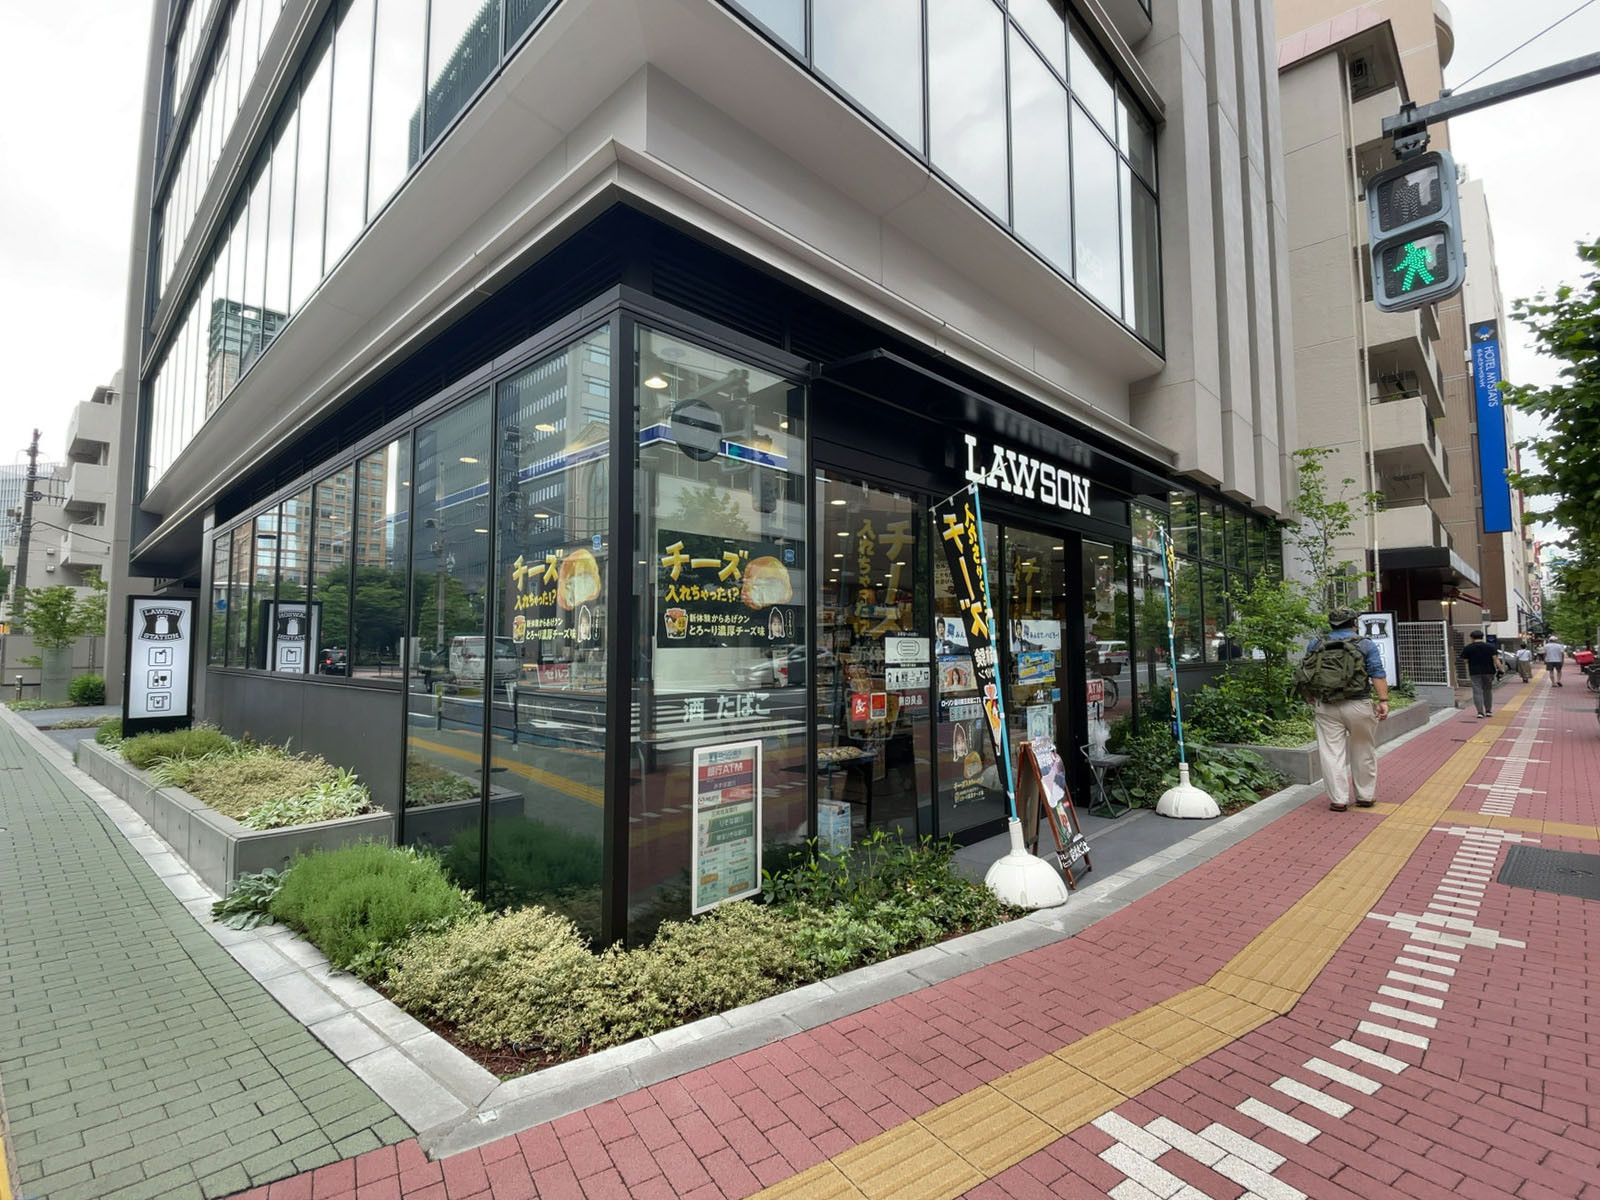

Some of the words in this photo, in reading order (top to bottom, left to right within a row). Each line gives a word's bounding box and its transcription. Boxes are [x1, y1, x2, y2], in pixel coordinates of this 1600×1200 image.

[1484, 345, 1496, 371] HOTEL
[1486, 372, 1499, 408] MYSTAYS
[965, 434, 1091, 516] LAWSON
[513, 549, 564, 591] チーズ
[662, 541, 749, 582] チーズ
[144, 608, 181, 616] LAWSON
[143, 632, 179, 640] STATION
[683, 697, 705, 723] 酒
[716, 691, 771, 720] たばこ
